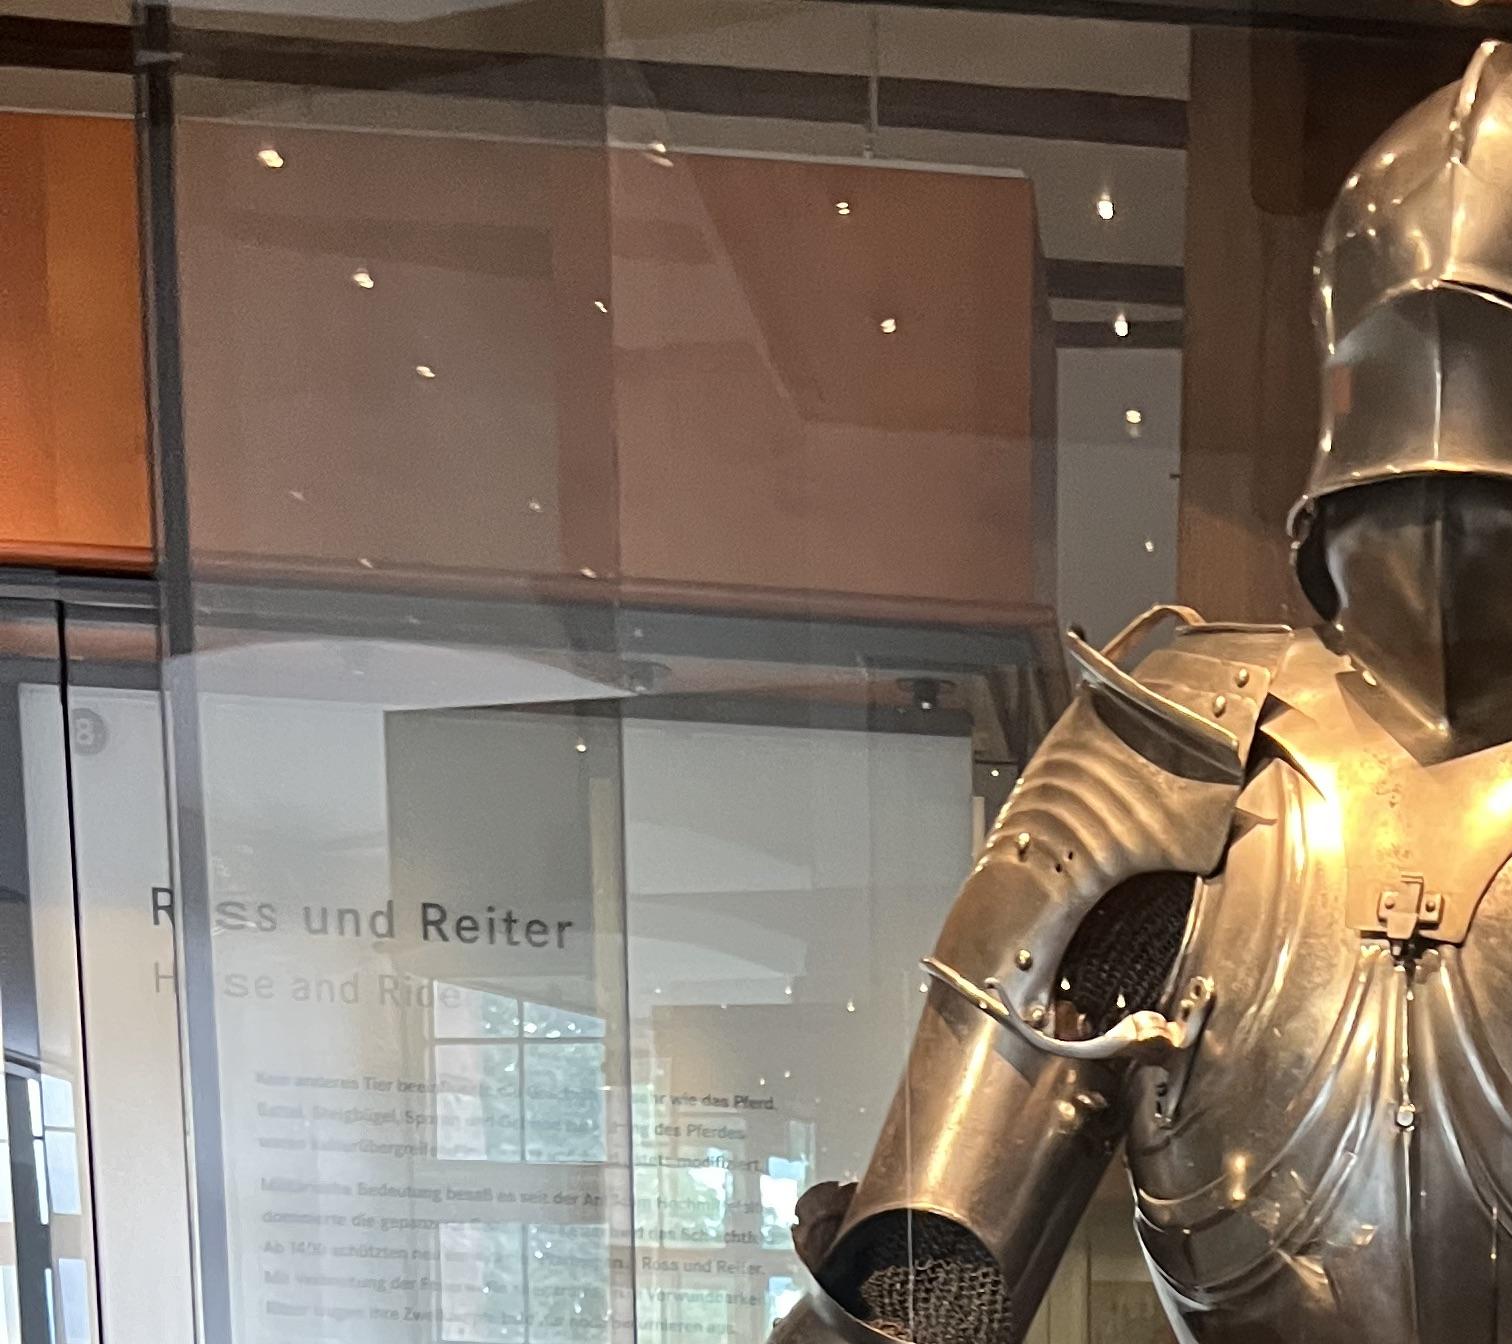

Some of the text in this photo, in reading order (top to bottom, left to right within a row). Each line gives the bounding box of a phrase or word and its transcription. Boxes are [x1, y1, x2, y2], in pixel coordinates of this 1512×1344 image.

[152, 887, 573, 949] Rss und Reiter
[155, 963, 472, 1008] Hse and Ride
